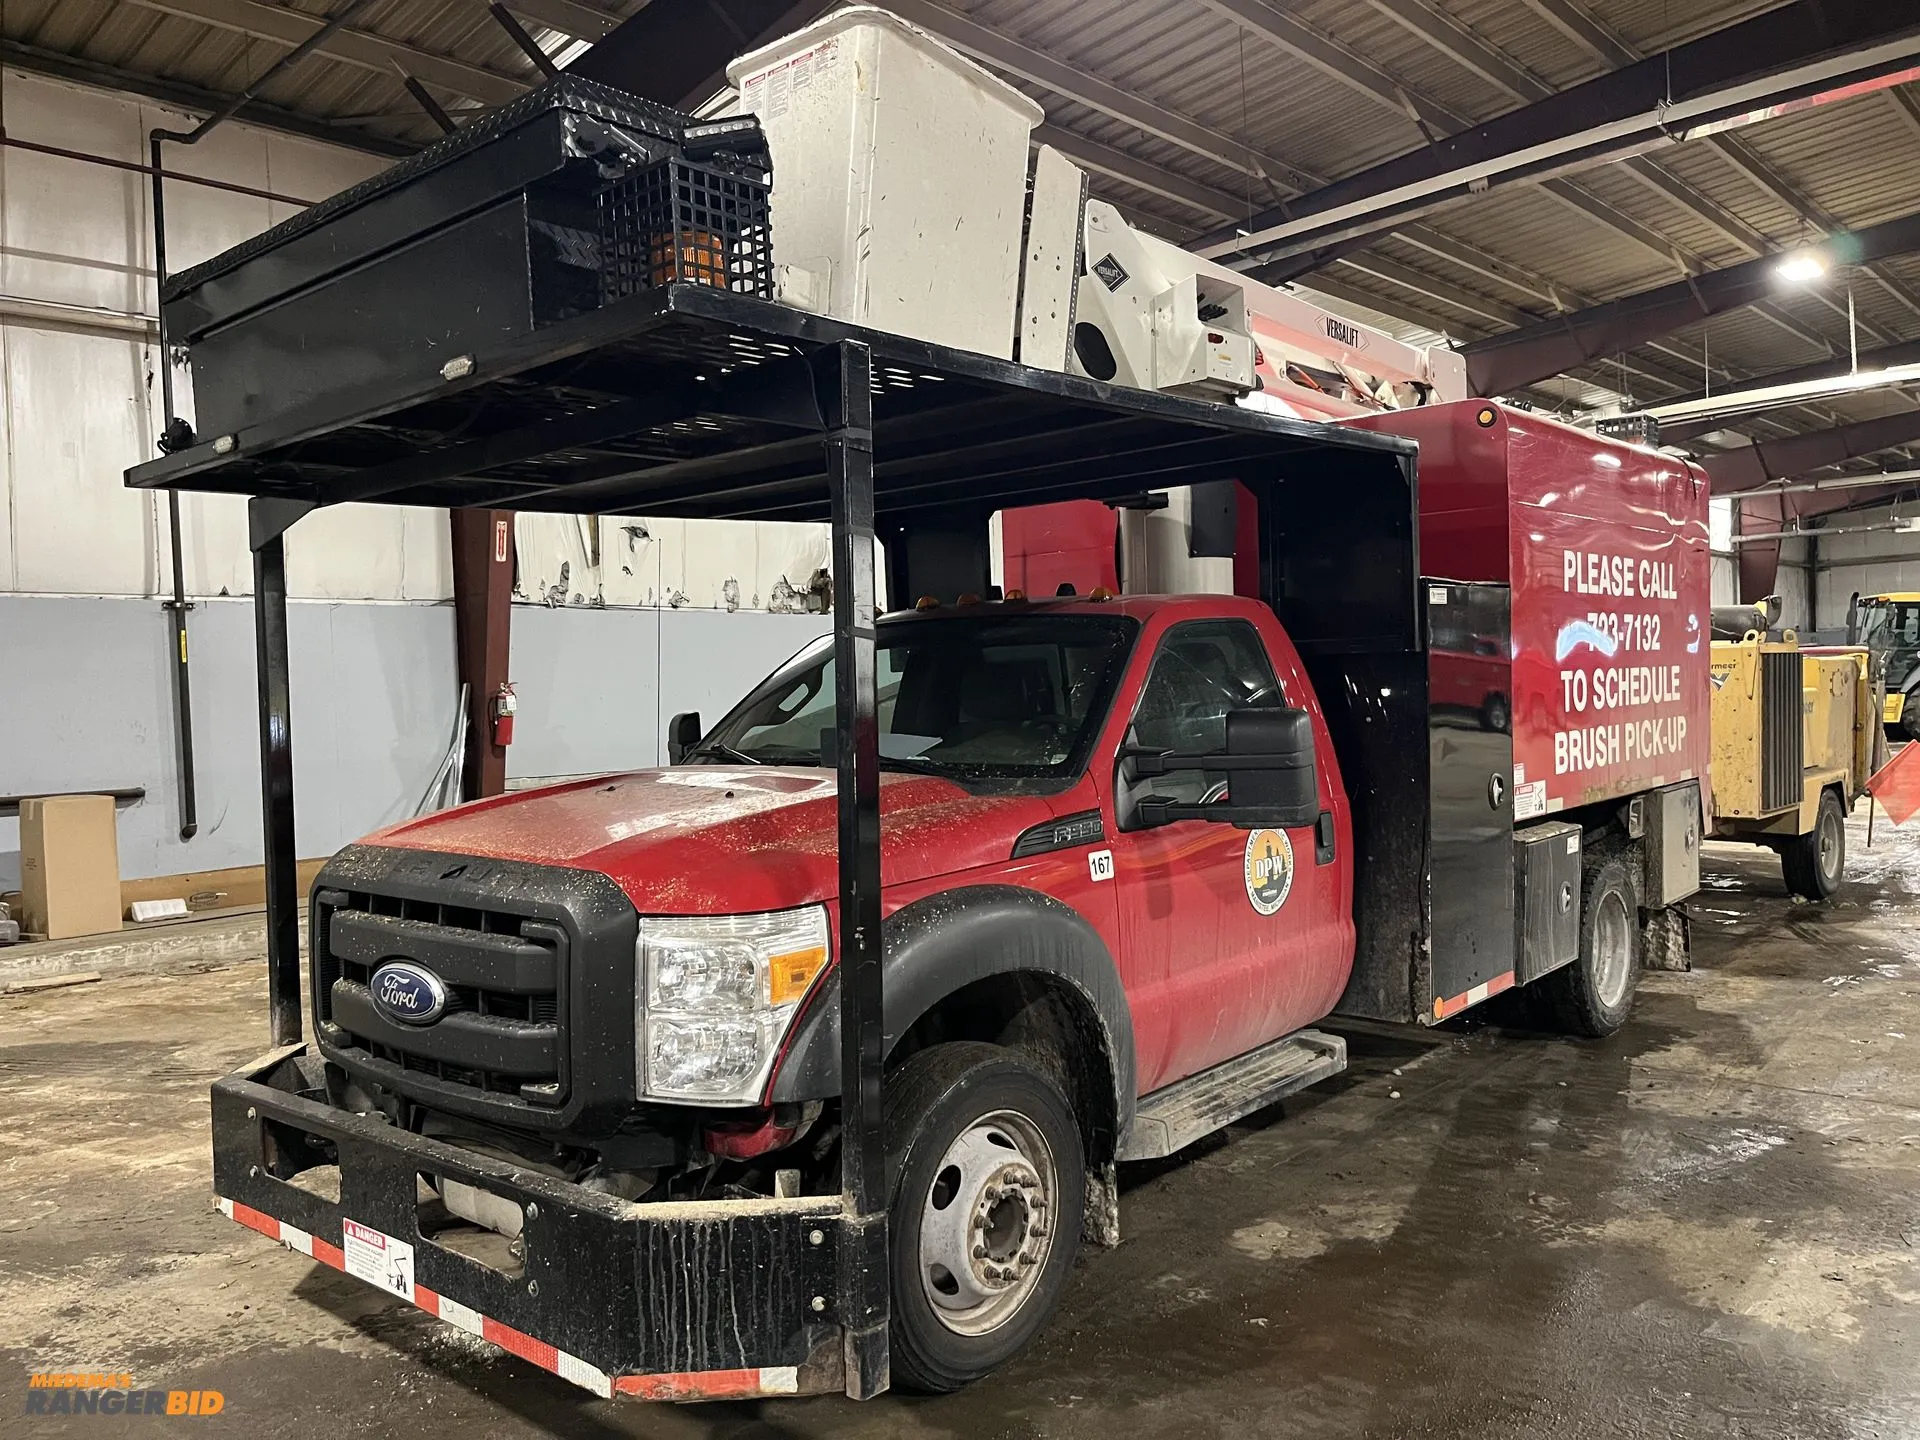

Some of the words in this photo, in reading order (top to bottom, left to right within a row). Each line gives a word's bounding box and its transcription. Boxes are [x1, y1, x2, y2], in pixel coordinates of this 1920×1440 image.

[1326, 316, 1359, 349] VERSALIFT
[1563, 550, 1634, 597] PLEASE
[1639, 559, 1678, 600] CALL
[1561, 668, 1588, 713] TO
[1593, 665, 1681, 710] SCHEDULE
[1554, 725, 1620, 775] BRUSH
[1625, 715, 1687, 761] PICK-UP
[1091, 855, 1110, 875] 167
[1255, 854, 1284, 880] DPW
[380, 972, 420, 1009] Ford
[355, 1226, 384, 1249] DANGER
